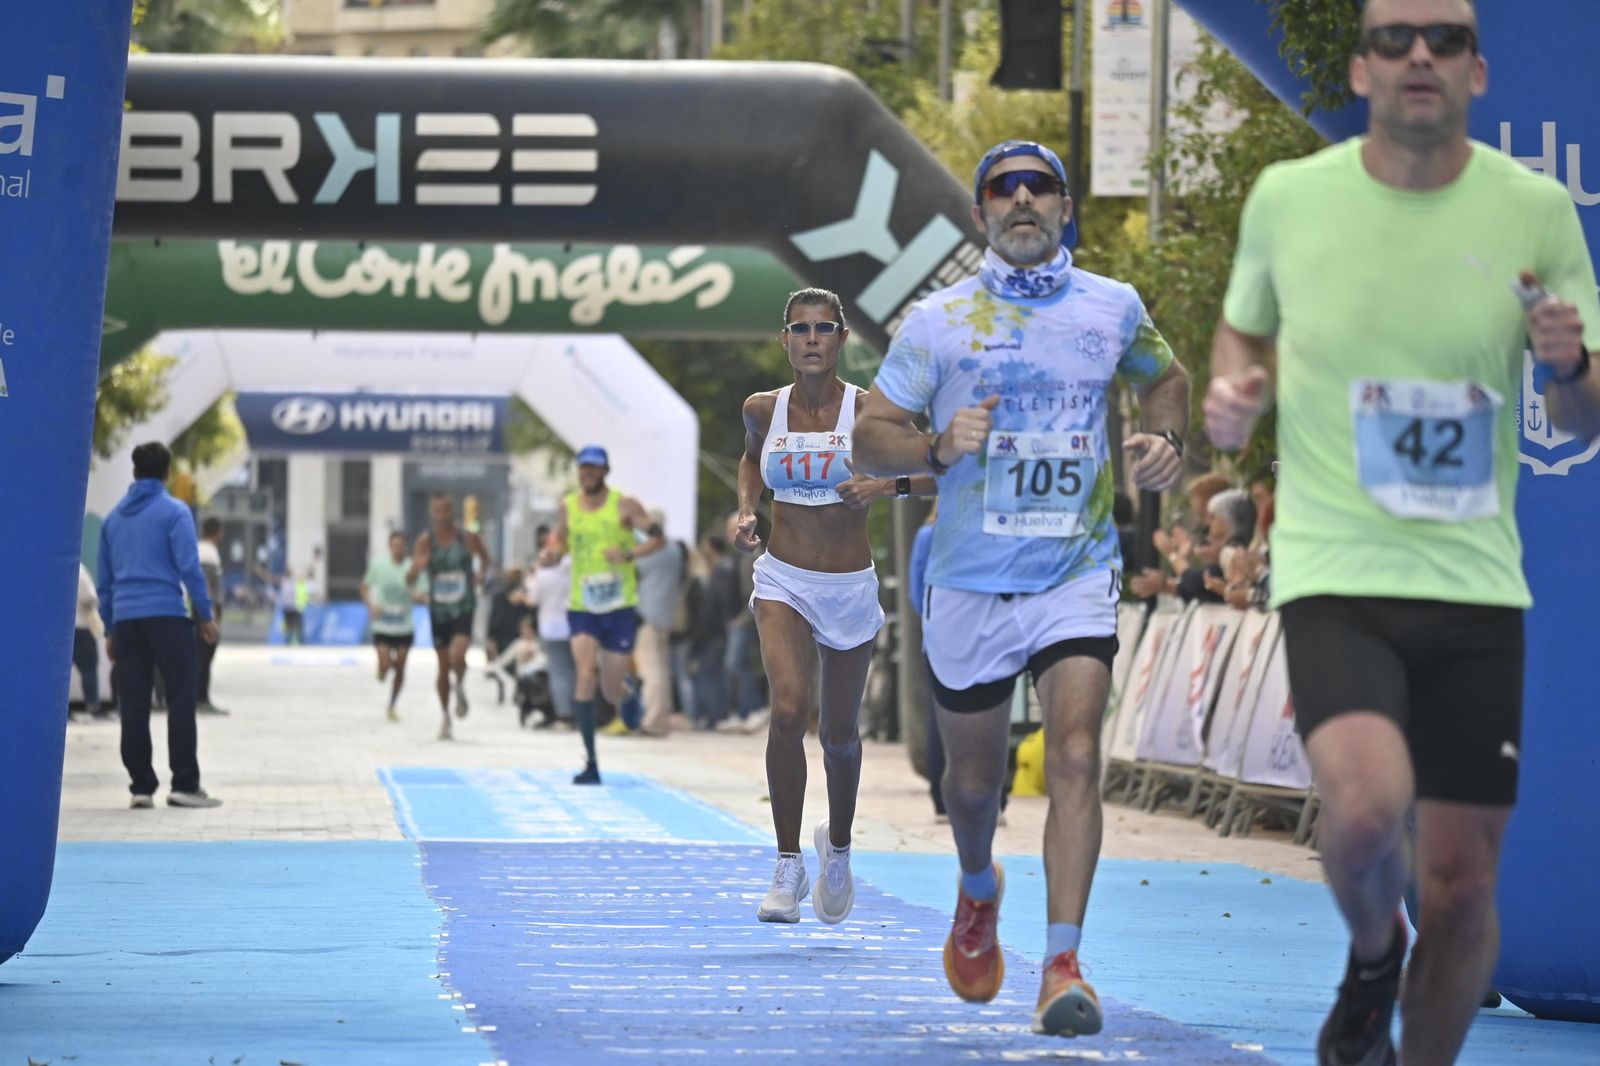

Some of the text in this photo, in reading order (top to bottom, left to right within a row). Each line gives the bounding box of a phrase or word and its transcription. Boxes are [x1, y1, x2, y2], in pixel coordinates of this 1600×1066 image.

[339, 401, 495, 431] HYUNDAI
[1393, 417, 1465, 468] 42
[780, 452, 836, 480] 117
[1007, 459, 1082, 498] 105
[1014, 514, 1064, 528] Huelva
